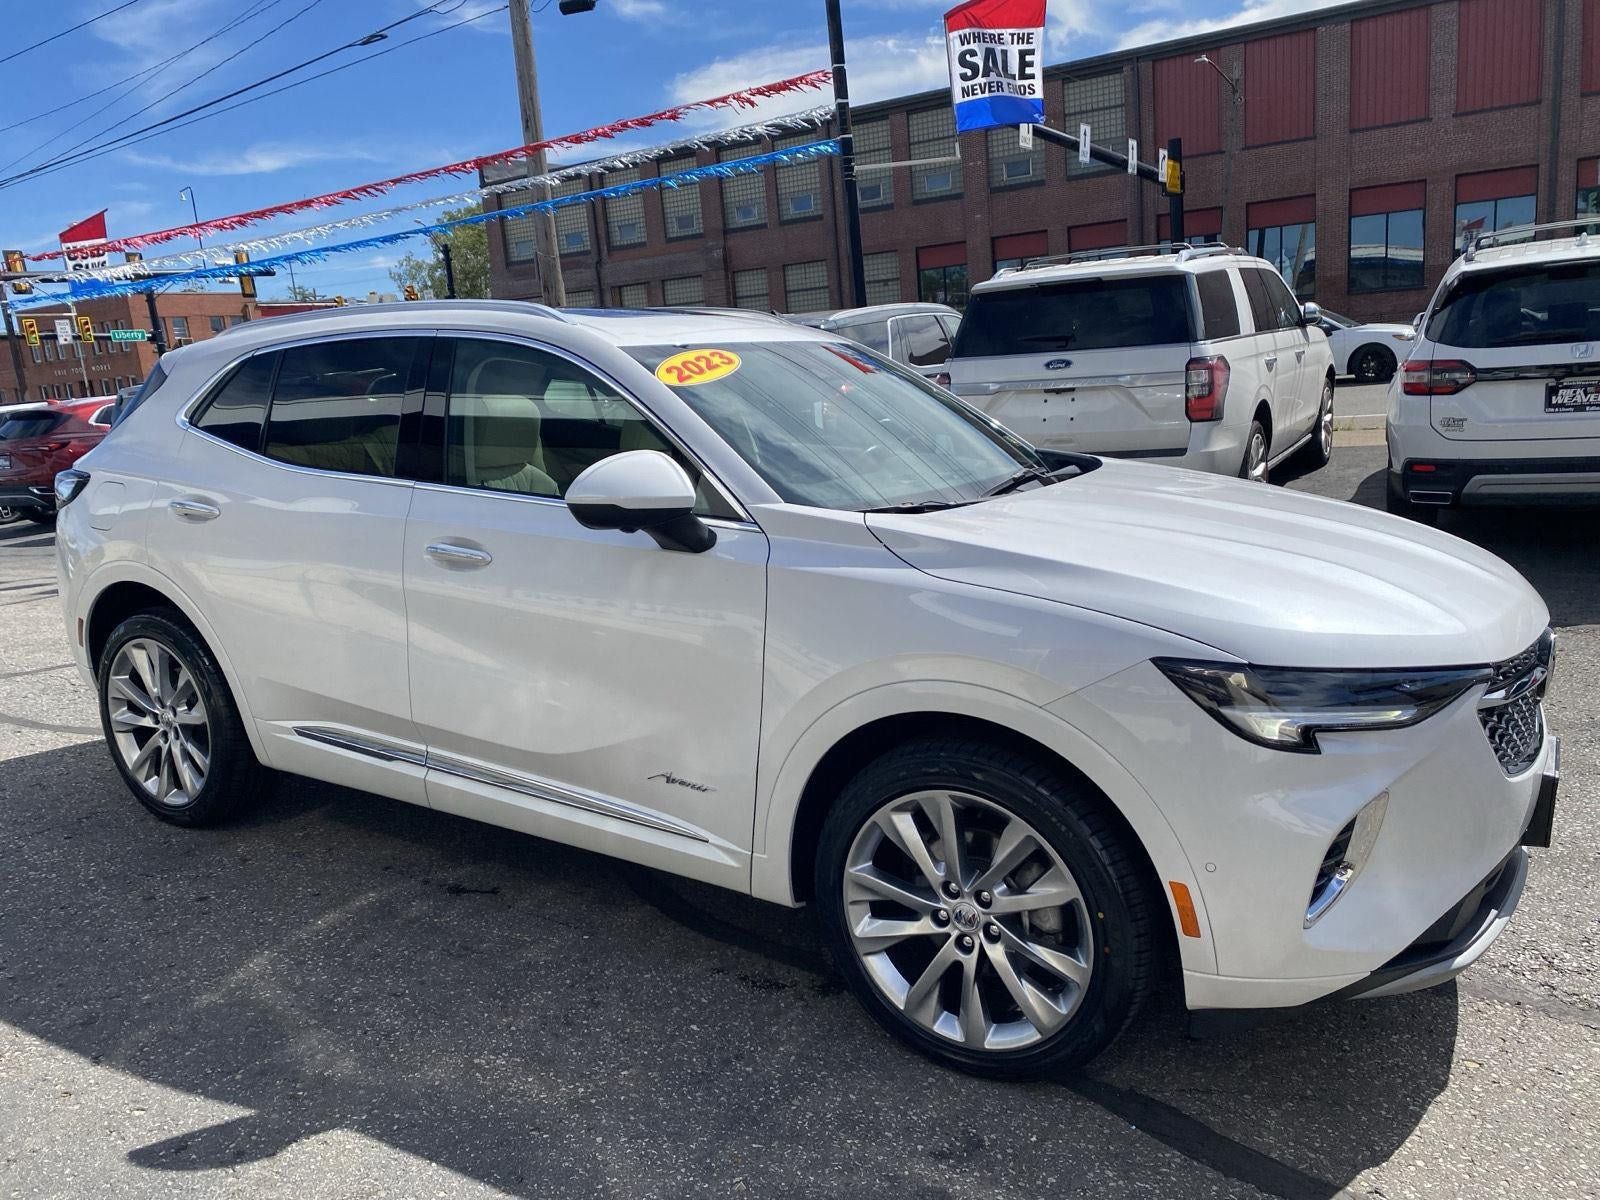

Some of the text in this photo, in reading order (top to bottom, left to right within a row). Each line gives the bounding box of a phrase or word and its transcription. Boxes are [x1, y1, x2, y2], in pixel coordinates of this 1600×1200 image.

[958, 32, 1034, 46] WHERE THE
[957, 47, 1036, 82] SALE
[961, 80, 1036, 98] NEVER ENDS
[114, 331, 142, 340] Liberty
[665, 351, 734, 383] 2023
[1049, 361, 1067, 369] Ford
[1557, 387, 1586, 397] RICK
